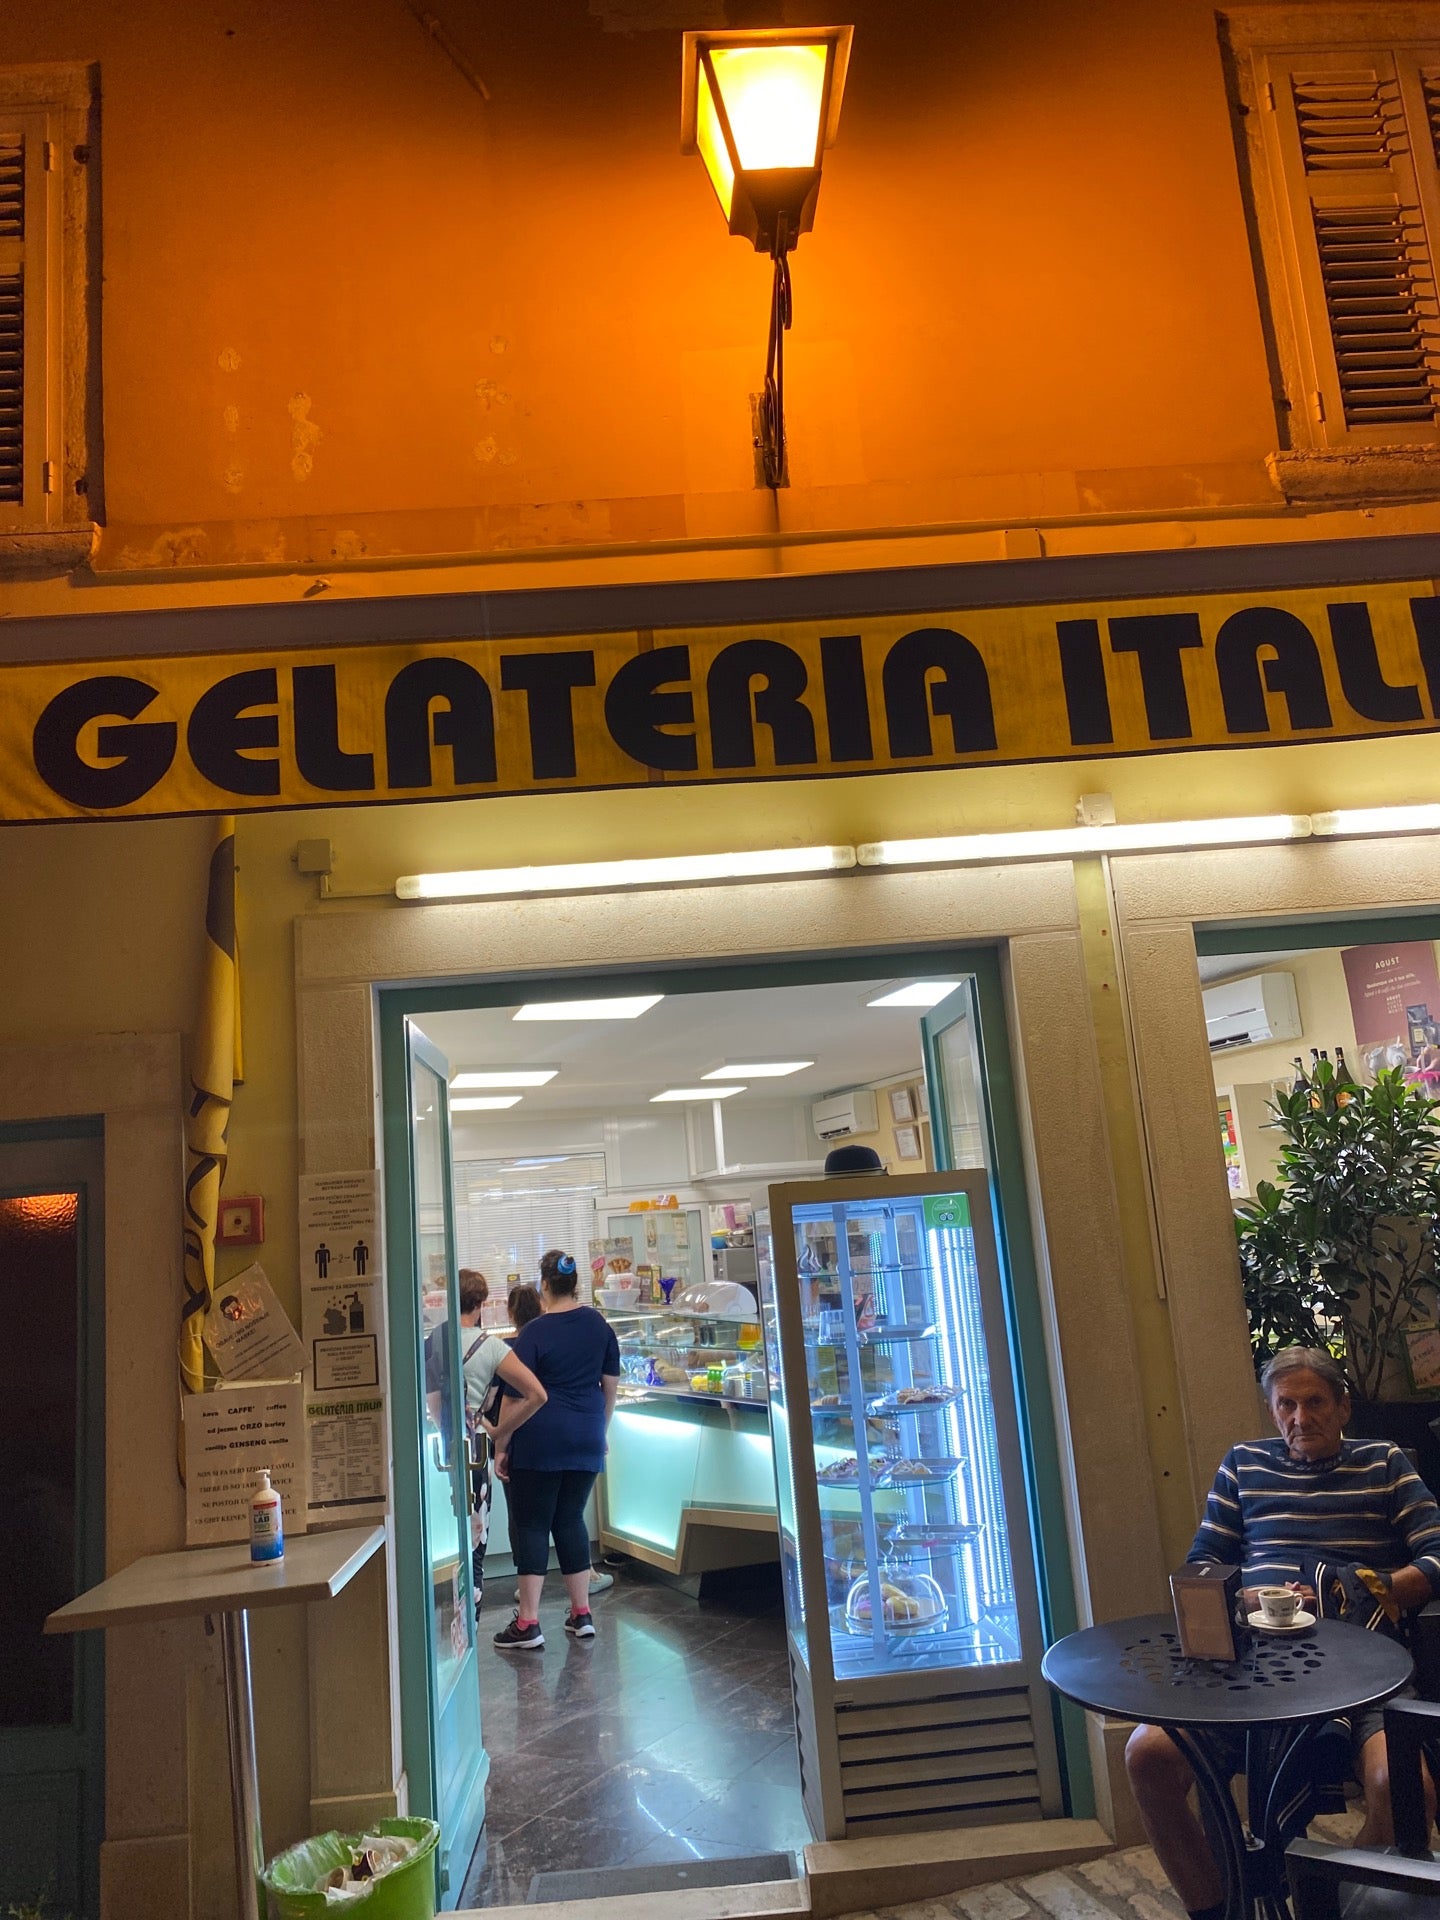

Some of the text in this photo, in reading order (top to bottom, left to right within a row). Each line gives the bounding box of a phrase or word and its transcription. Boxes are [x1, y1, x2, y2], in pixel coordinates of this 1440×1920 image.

[33, 628, 998, 810] GELATERIA
[1375, 956, 1400, 970] AGUST
[308, 1403, 354, 1416] GELATERIA
[240, 1422, 263, 1431] ORZO
[229, 1439, 267, 1449] GINSENG
